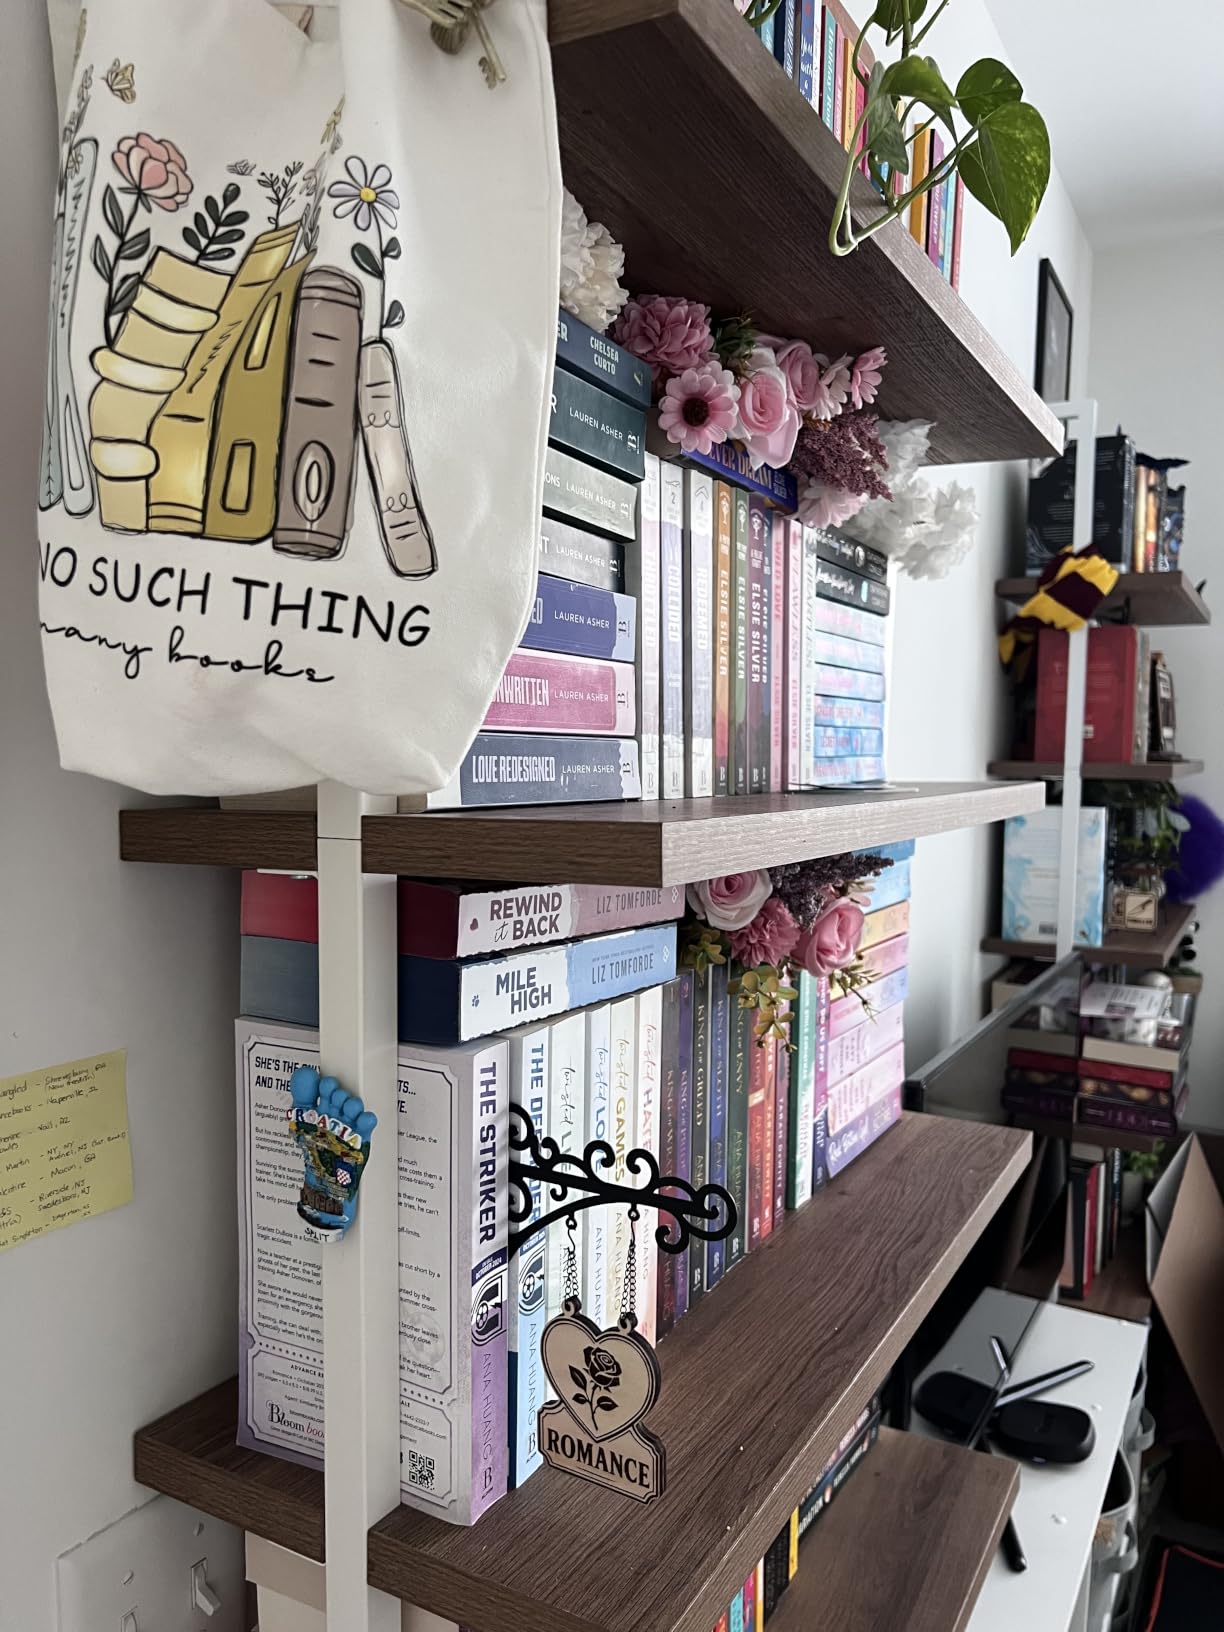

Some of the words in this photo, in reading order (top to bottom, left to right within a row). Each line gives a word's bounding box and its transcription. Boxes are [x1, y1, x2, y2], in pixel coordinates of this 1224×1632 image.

[590, 336, 619, 363] CHELSEA
[594, 353, 616, 375] CURTO
[569, 407, 599, 429] LAUREN
[600, 423, 623, 441] ASHER
[566, 482, 594, 501] LAUREN
[595, 493, 616, 511] ASHER
[556, 544, 583, 561] LAUREN
[584, 554, 606, 568] ASHER
[88, 556, 211, 616] SUCH
[232, 576, 431, 648] THING
[668, 565, 681, 643] COLLIDED
[696, 567, 708, 650] REDEEMED
[719, 569, 729, 615] ELSIE
[738, 577, 746, 621] ELSIE
[751, 583, 761, 626] ELSIE
[554, 610, 584, 624] LAUREN
[586, 616, 610, 629] ASHER
[168, 625, 335, 683] books
[719, 620, 729, 676] SILVER
[737, 625, 746, 679] SILVER
[751, 630, 761, 683] SILVER
[493, 675, 550, 706] NWRITTEN
[554, 689, 584, 701] LAUREN
[586, 693, 609, 703] ASHER
[472, 755, 498, 783] LOVE
[499, 756, 556, 783] REDESIGNED
[562, 764, 591, 774] LAUREN
[593, 764, 615, 774] ASHER
[490, 892, 562, 921] REWIND
[596, 895, 612, 915] LIZ
[615, 888, 662, 912] TOMFORDE
[494, 921, 508, 943] it
[512, 914, 560, 941] BACK
[496, 966, 537, 996] MILE
[510, 984, 552, 1014] HIGH
[592, 964, 606, 985] LIZ
[609, 952, 654, 980] TOMFORDE
[697, 1005, 705, 1048] KING
[255, 1056, 280, 1071] SHE'S
[255, 1075, 273, 1089] AND
[275, 1078, 291, 1092] THE
[530, 1043, 544, 1090] THE
[480, 1061, 497, 1117] THE
[286, 1107, 362, 1150] CROATIA
[595, 1106, 606, 1173] LOE
[615, 1097, 625, 1182] GAMES
[479, 1124, 497, 1245] STRIKER
[305, 1227, 330, 1243] SPLIT
[529, 1322, 537, 1360] ANA
[483, 1353, 492, 1393] ANA
[528, 1364, 537, 1426] HUANG
[267, 1402, 305, 1432] Bloom
[482, 1396, 493, 1461] HUANG
[546, 1428, 650, 1489] ROMANCE
